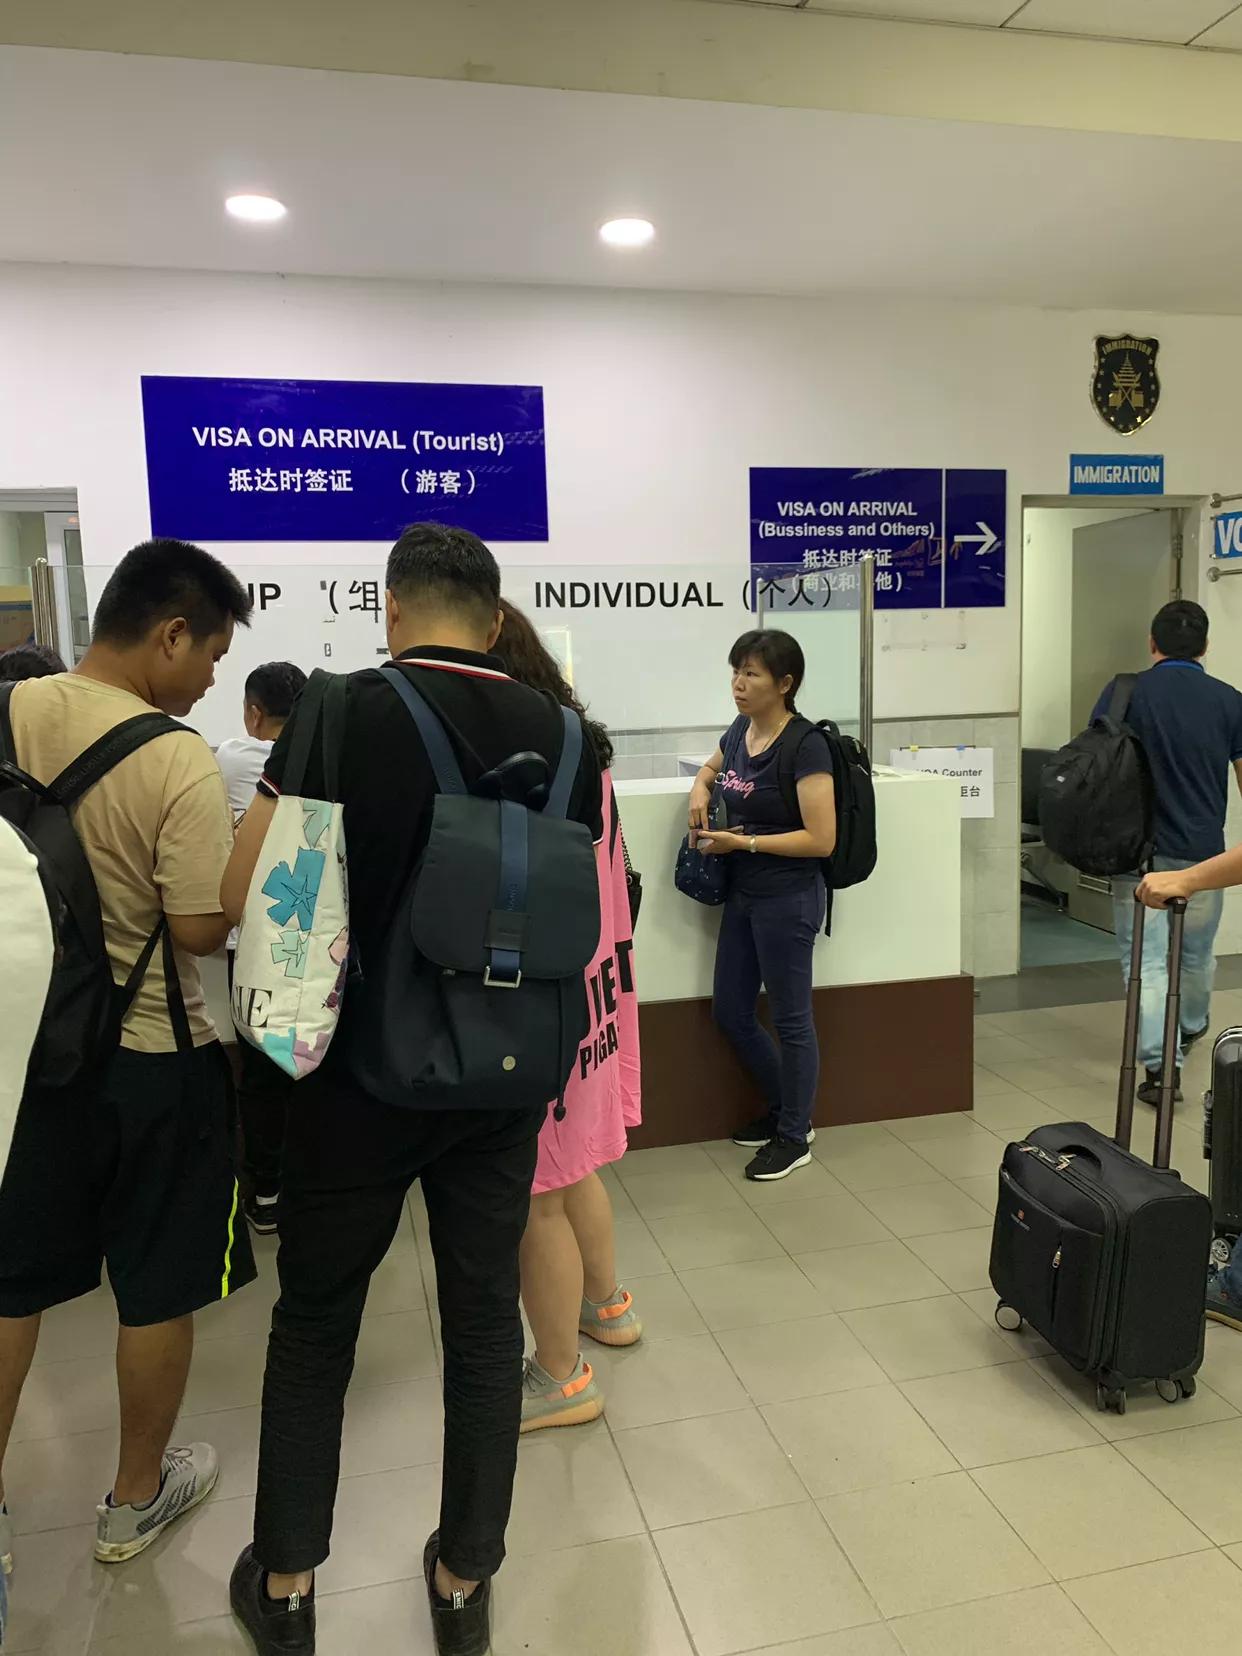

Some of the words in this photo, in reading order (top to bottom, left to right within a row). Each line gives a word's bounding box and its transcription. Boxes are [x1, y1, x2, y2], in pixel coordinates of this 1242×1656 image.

[191, 426, 253, 447] VISA
[258, 427, 294, 448] ON
[301, 428, 406, 450] ARRIVAL
[412, 430, 504, 456] (Tourist)
[228, 467, 353, 493] 抵达时签证
[1073, 465, 1160, 484] IMMIGRATION
[777, 501, 816, 517] VISA
[819, 502, 844, 517] ON
[847, 502, 918, 516] ARRIVAL
[758, 520, 844, 539] (Bussiness
[848, 521, 876, 536] and
[880, 522, 935, 539] Others)
[535, 582, 724, 608] INDIVIDUAL
[941, 768, 983, 777] Counter
